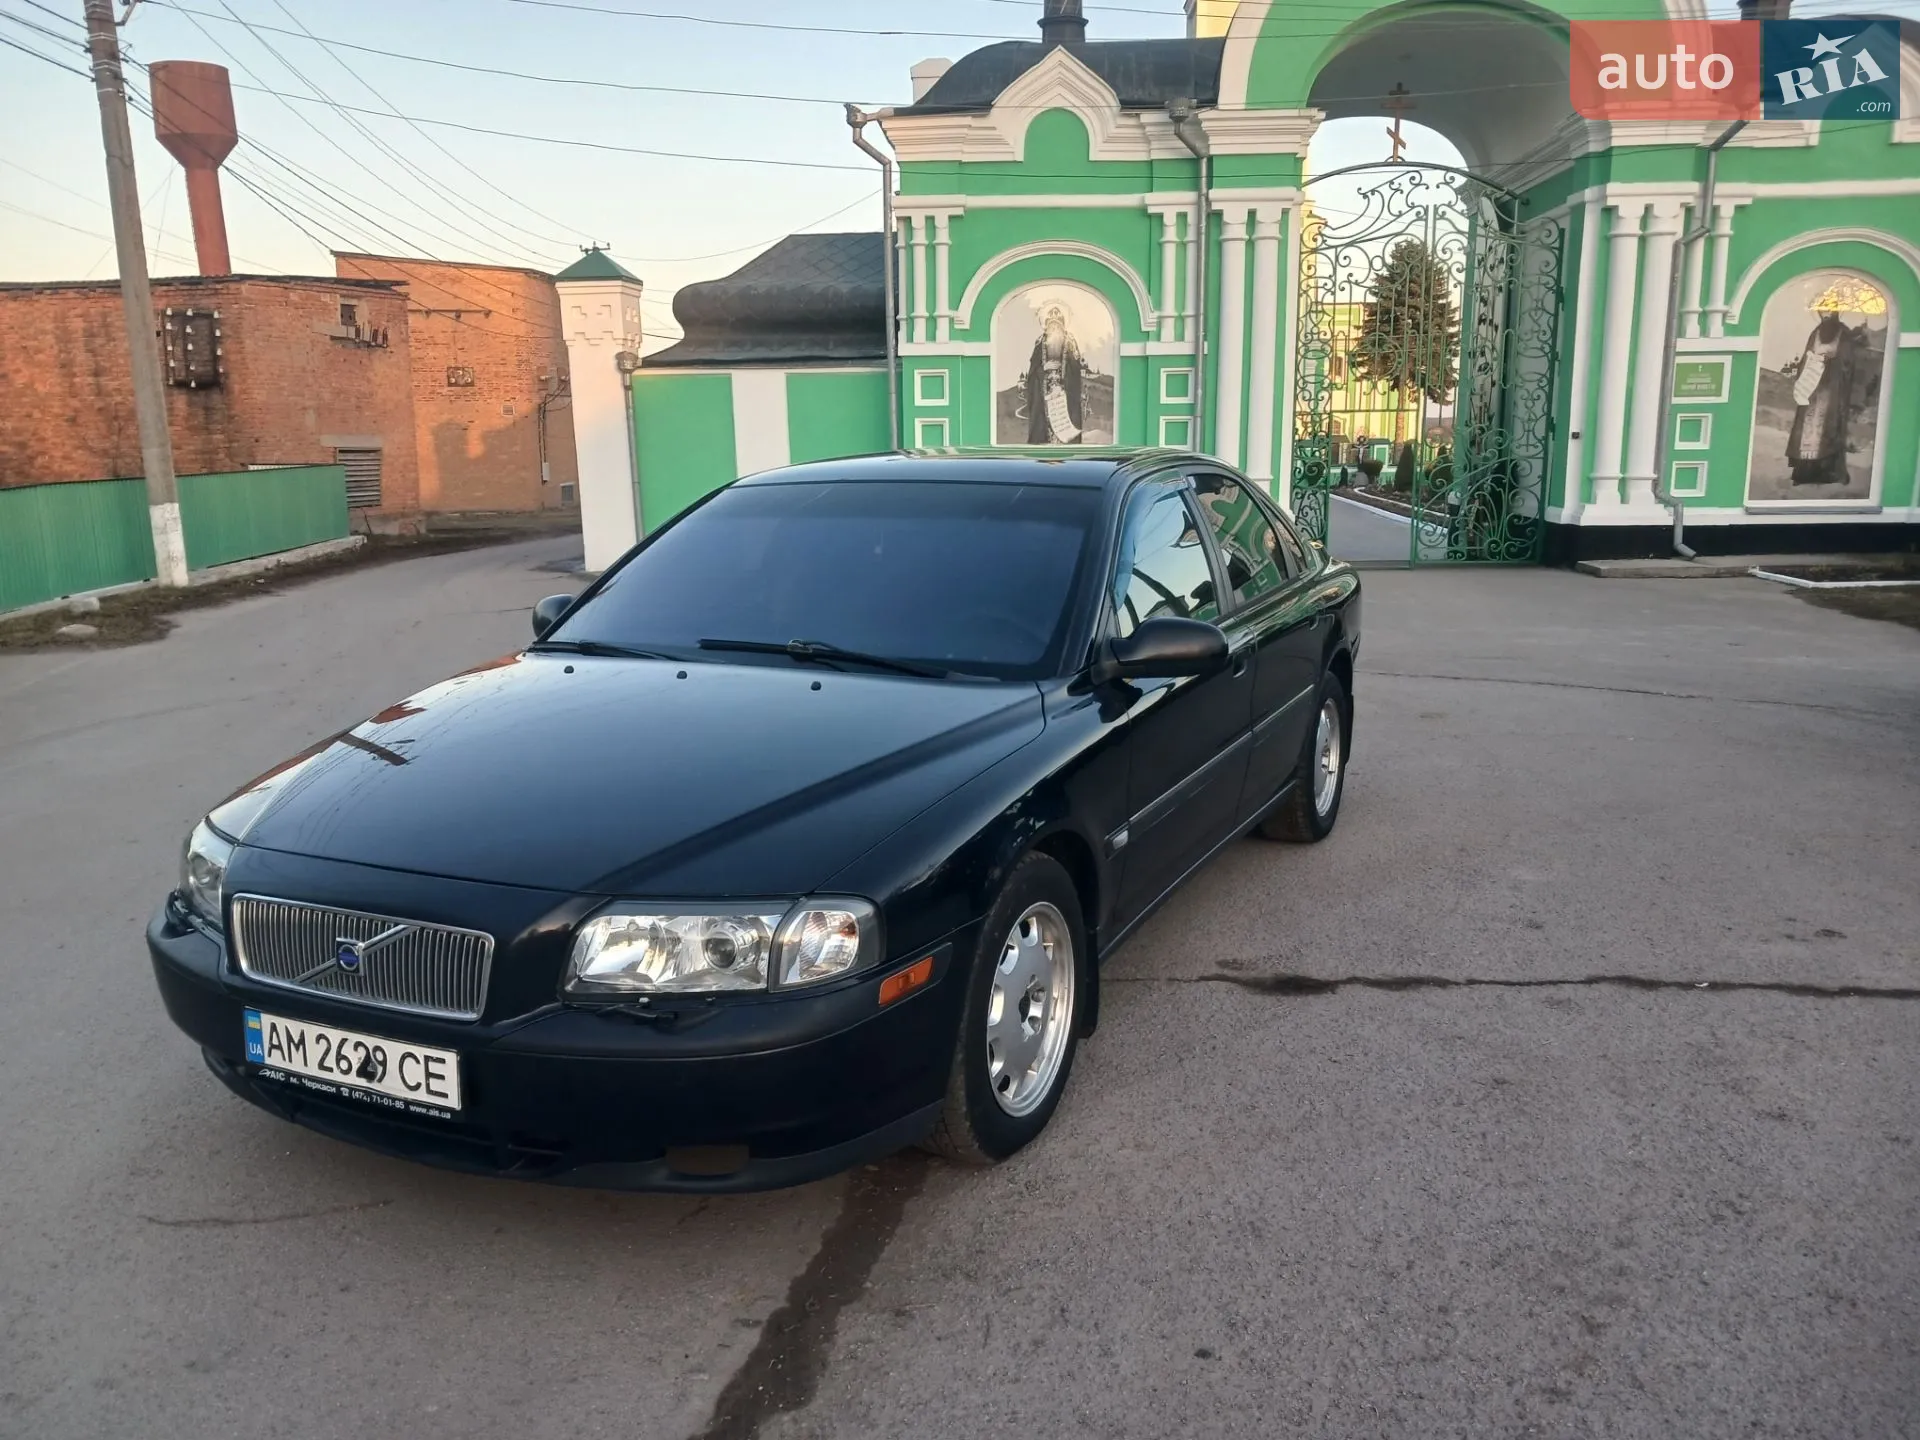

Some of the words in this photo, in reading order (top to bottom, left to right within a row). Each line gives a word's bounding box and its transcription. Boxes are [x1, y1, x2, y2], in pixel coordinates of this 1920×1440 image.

[250, 1043, 263, 1056] UA
[267, 1022, 308, 1068] AM
[399, 1051, 449, 1099] CE
[302, 1078, 337, 1094] Черкаси
[372, 1094, 405, 1109] 71-01-85
[408, 1104, 451, 1119] www.ais.ua
